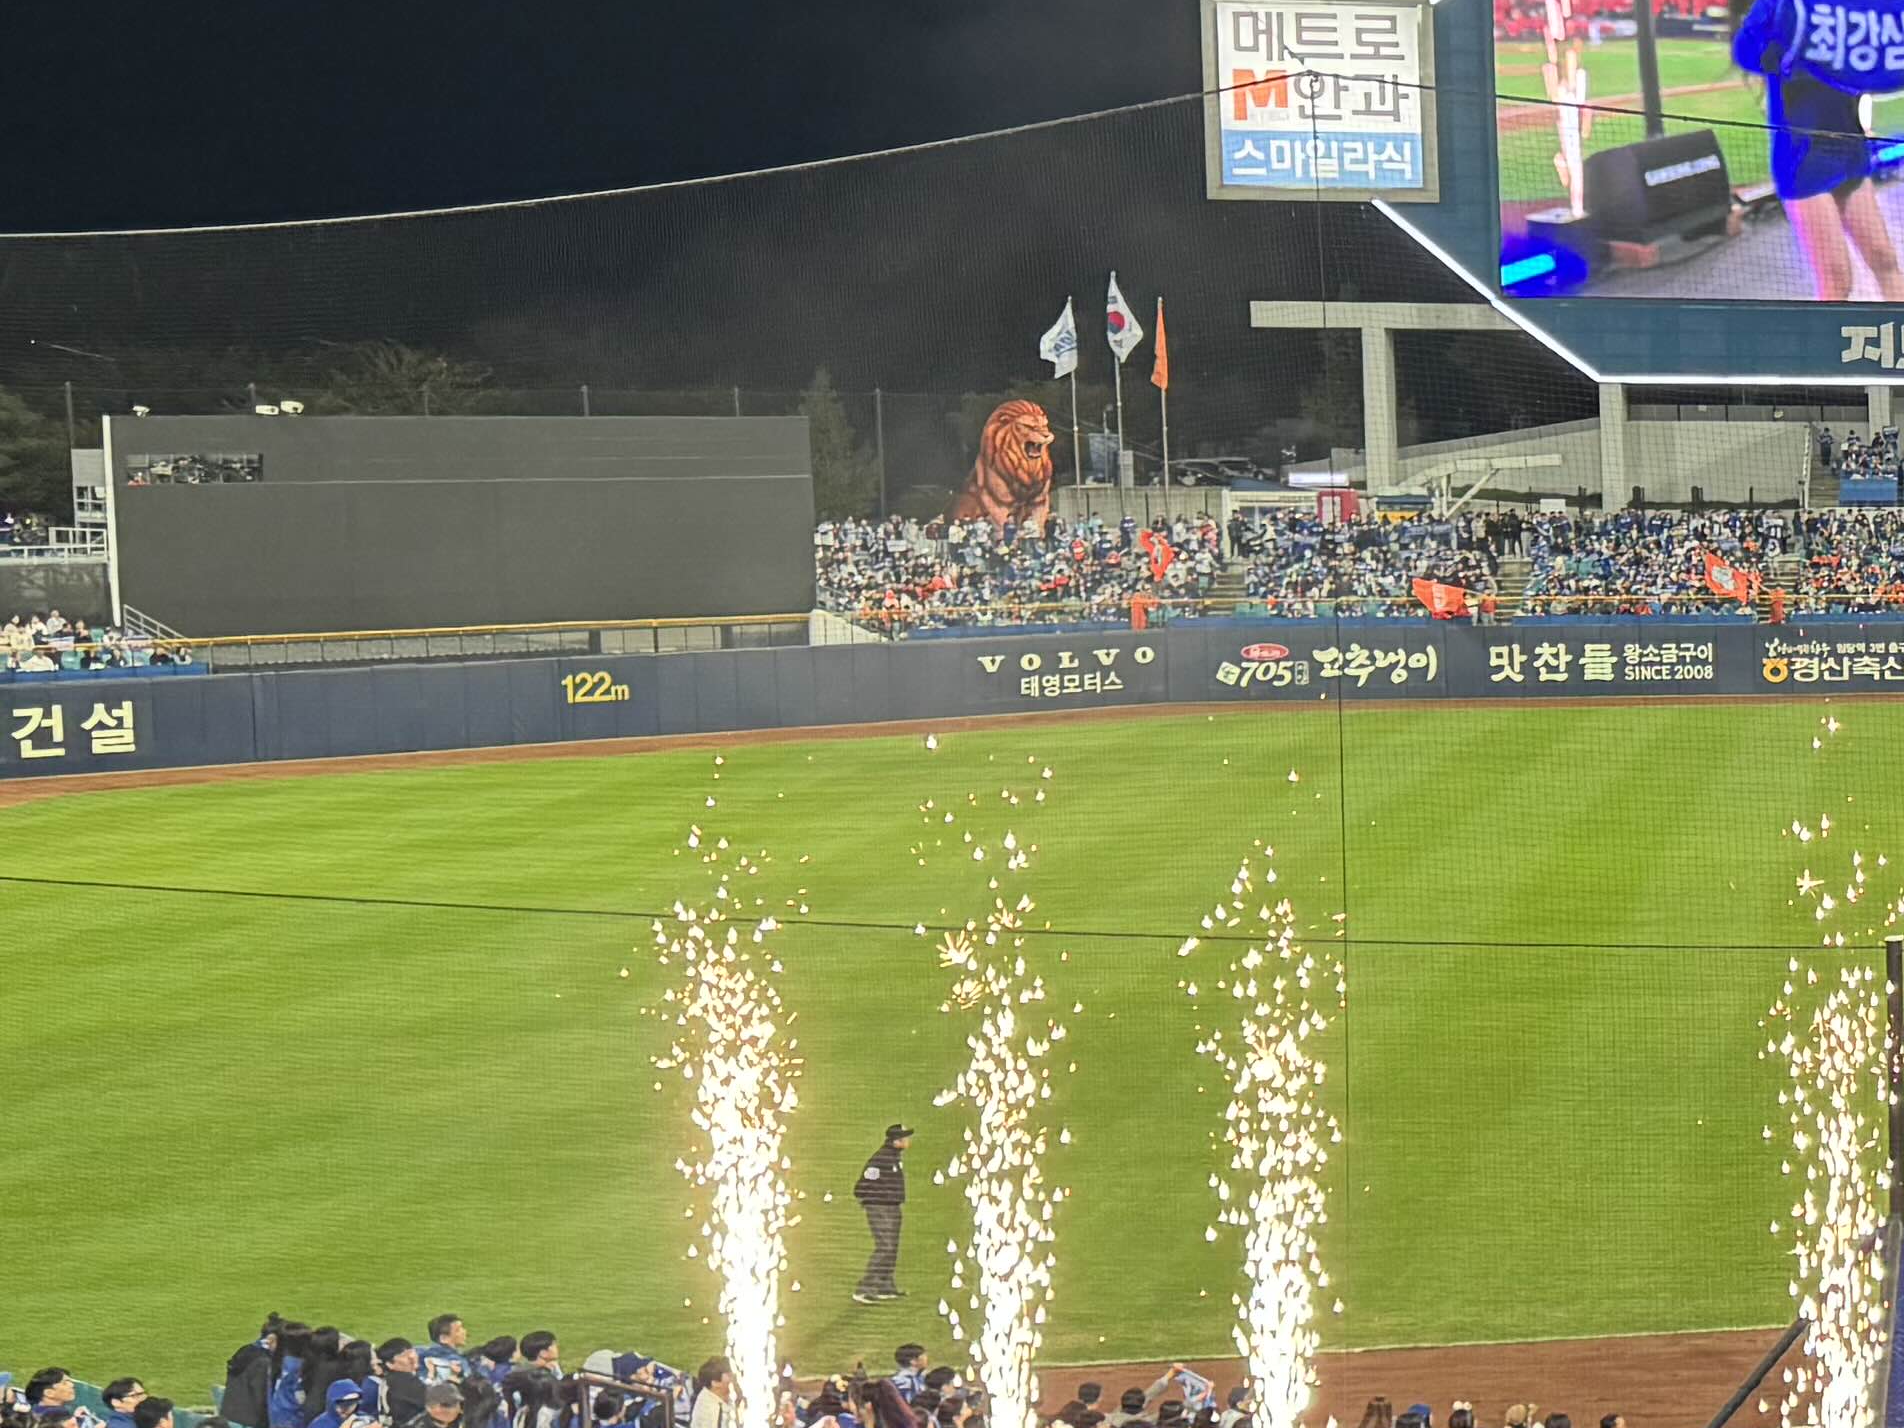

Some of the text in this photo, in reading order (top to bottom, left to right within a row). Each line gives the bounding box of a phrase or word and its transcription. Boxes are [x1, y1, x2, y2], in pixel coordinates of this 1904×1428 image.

[1232, 11, 1405, 62] 메트로
[1294, 72, 1410, 122] 안과
[1232, 138, 1413, 181] 스마일라식
[976, 646, 1156, 673] VOLVO
[1488, 642, 1618, 682] 맛찬들
[1623, 642, 1713, 664] 왕소금구이
[561, 671, 630, 705] 122m
[1020, 671, 1125, 697] 태영모터스
[1239, 660, 1295, 688] 705
[1624, 665, 1714, 681] SINCE 2008
[10, 699, 137, 760] 건설
